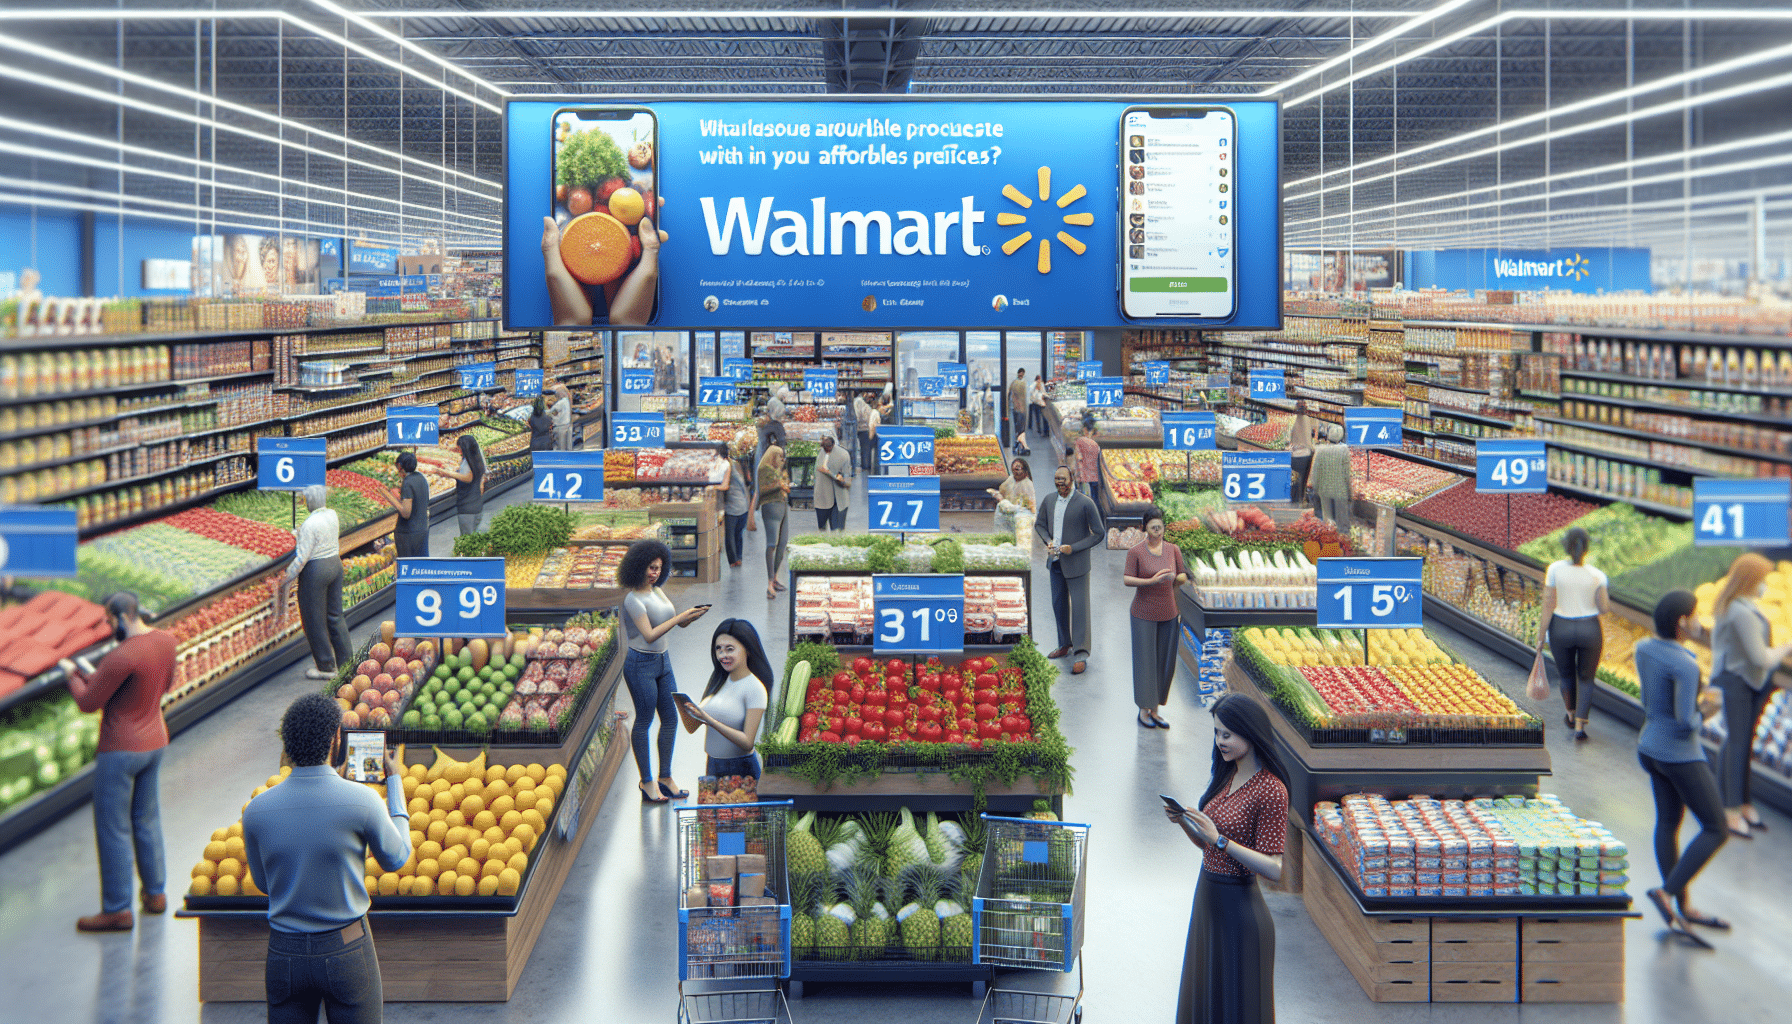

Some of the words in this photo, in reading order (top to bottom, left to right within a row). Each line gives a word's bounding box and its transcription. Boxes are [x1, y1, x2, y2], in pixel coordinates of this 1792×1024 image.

[699, 145, 743, 165] with
[749, 145, 766, 165] in
[772, 151, 810, 170] you
[700, 195, 985, 256] Walmart
[1494, 258, 1564, 278] Walmart
[275, 456, 295, 483] 6
[1700, 504, 1745, 538] 41
